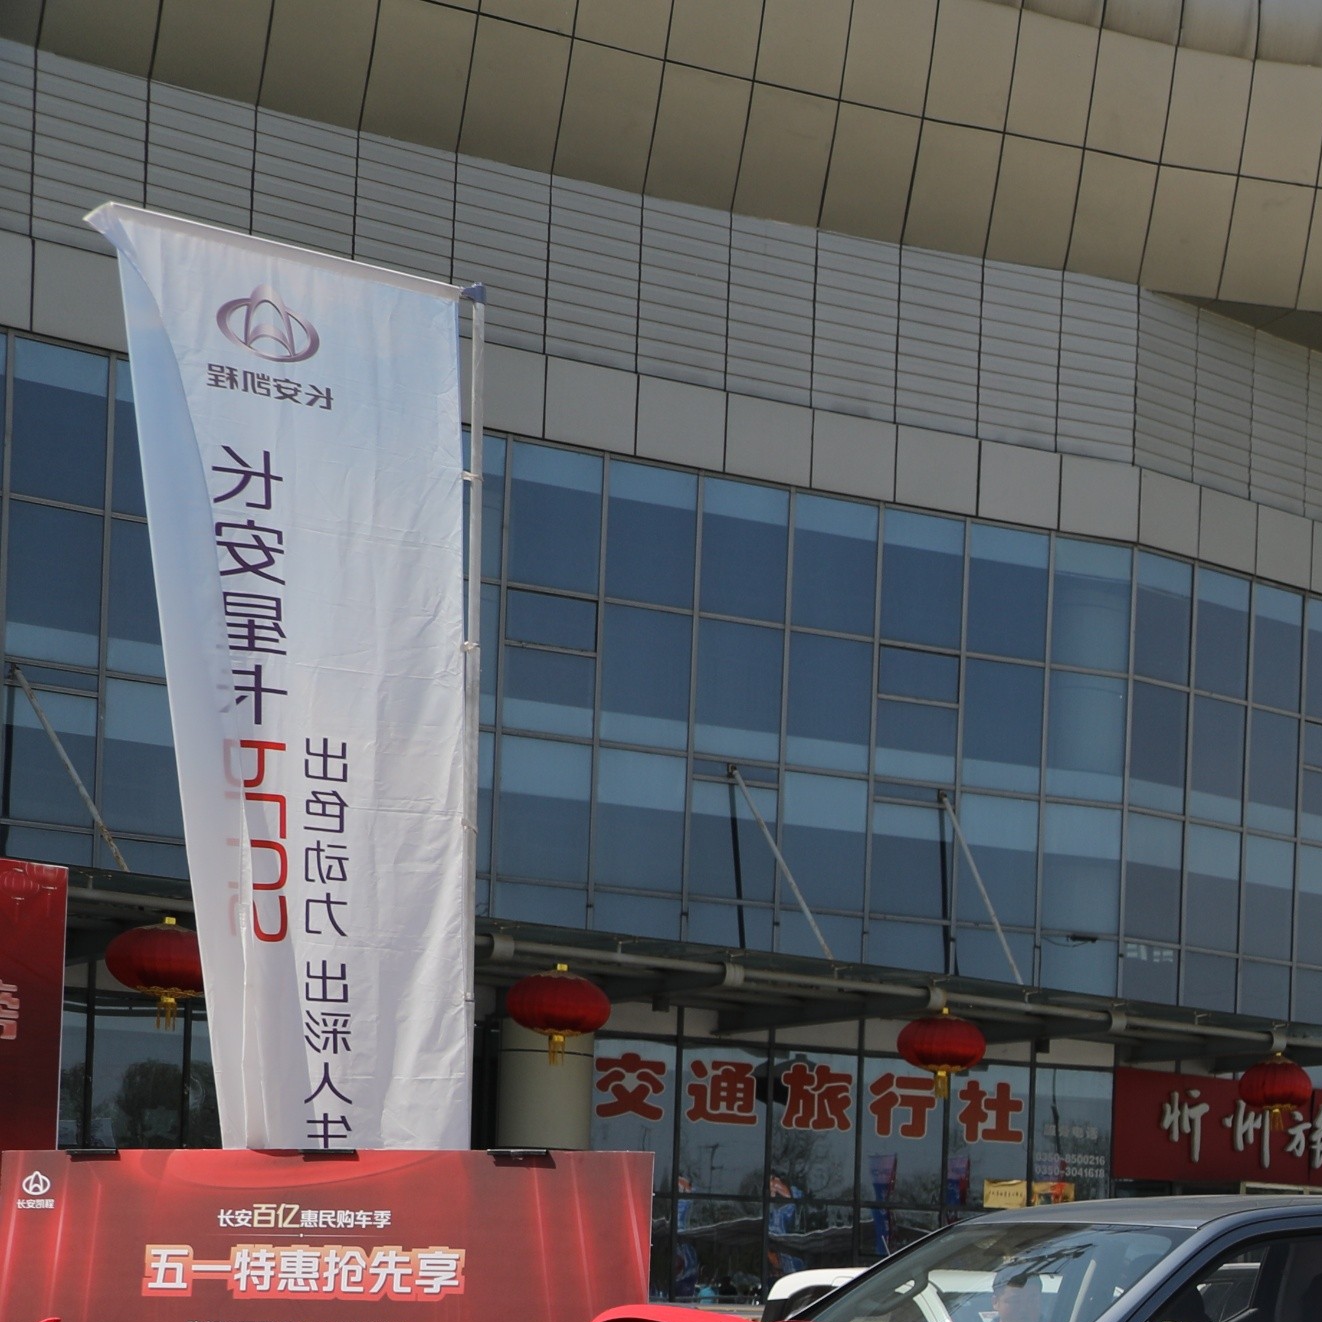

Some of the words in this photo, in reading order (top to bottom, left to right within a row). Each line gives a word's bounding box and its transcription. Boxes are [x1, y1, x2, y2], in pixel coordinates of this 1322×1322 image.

[595, 1051, 1025, 1145] 交通旅行社
[16, 1198, 55, 1210] 长安凯程
[217, 1203, 392, 1229] 长安百亿惠民购车季
[147, 1247, 460, 1295] 五一特惠抢先享
